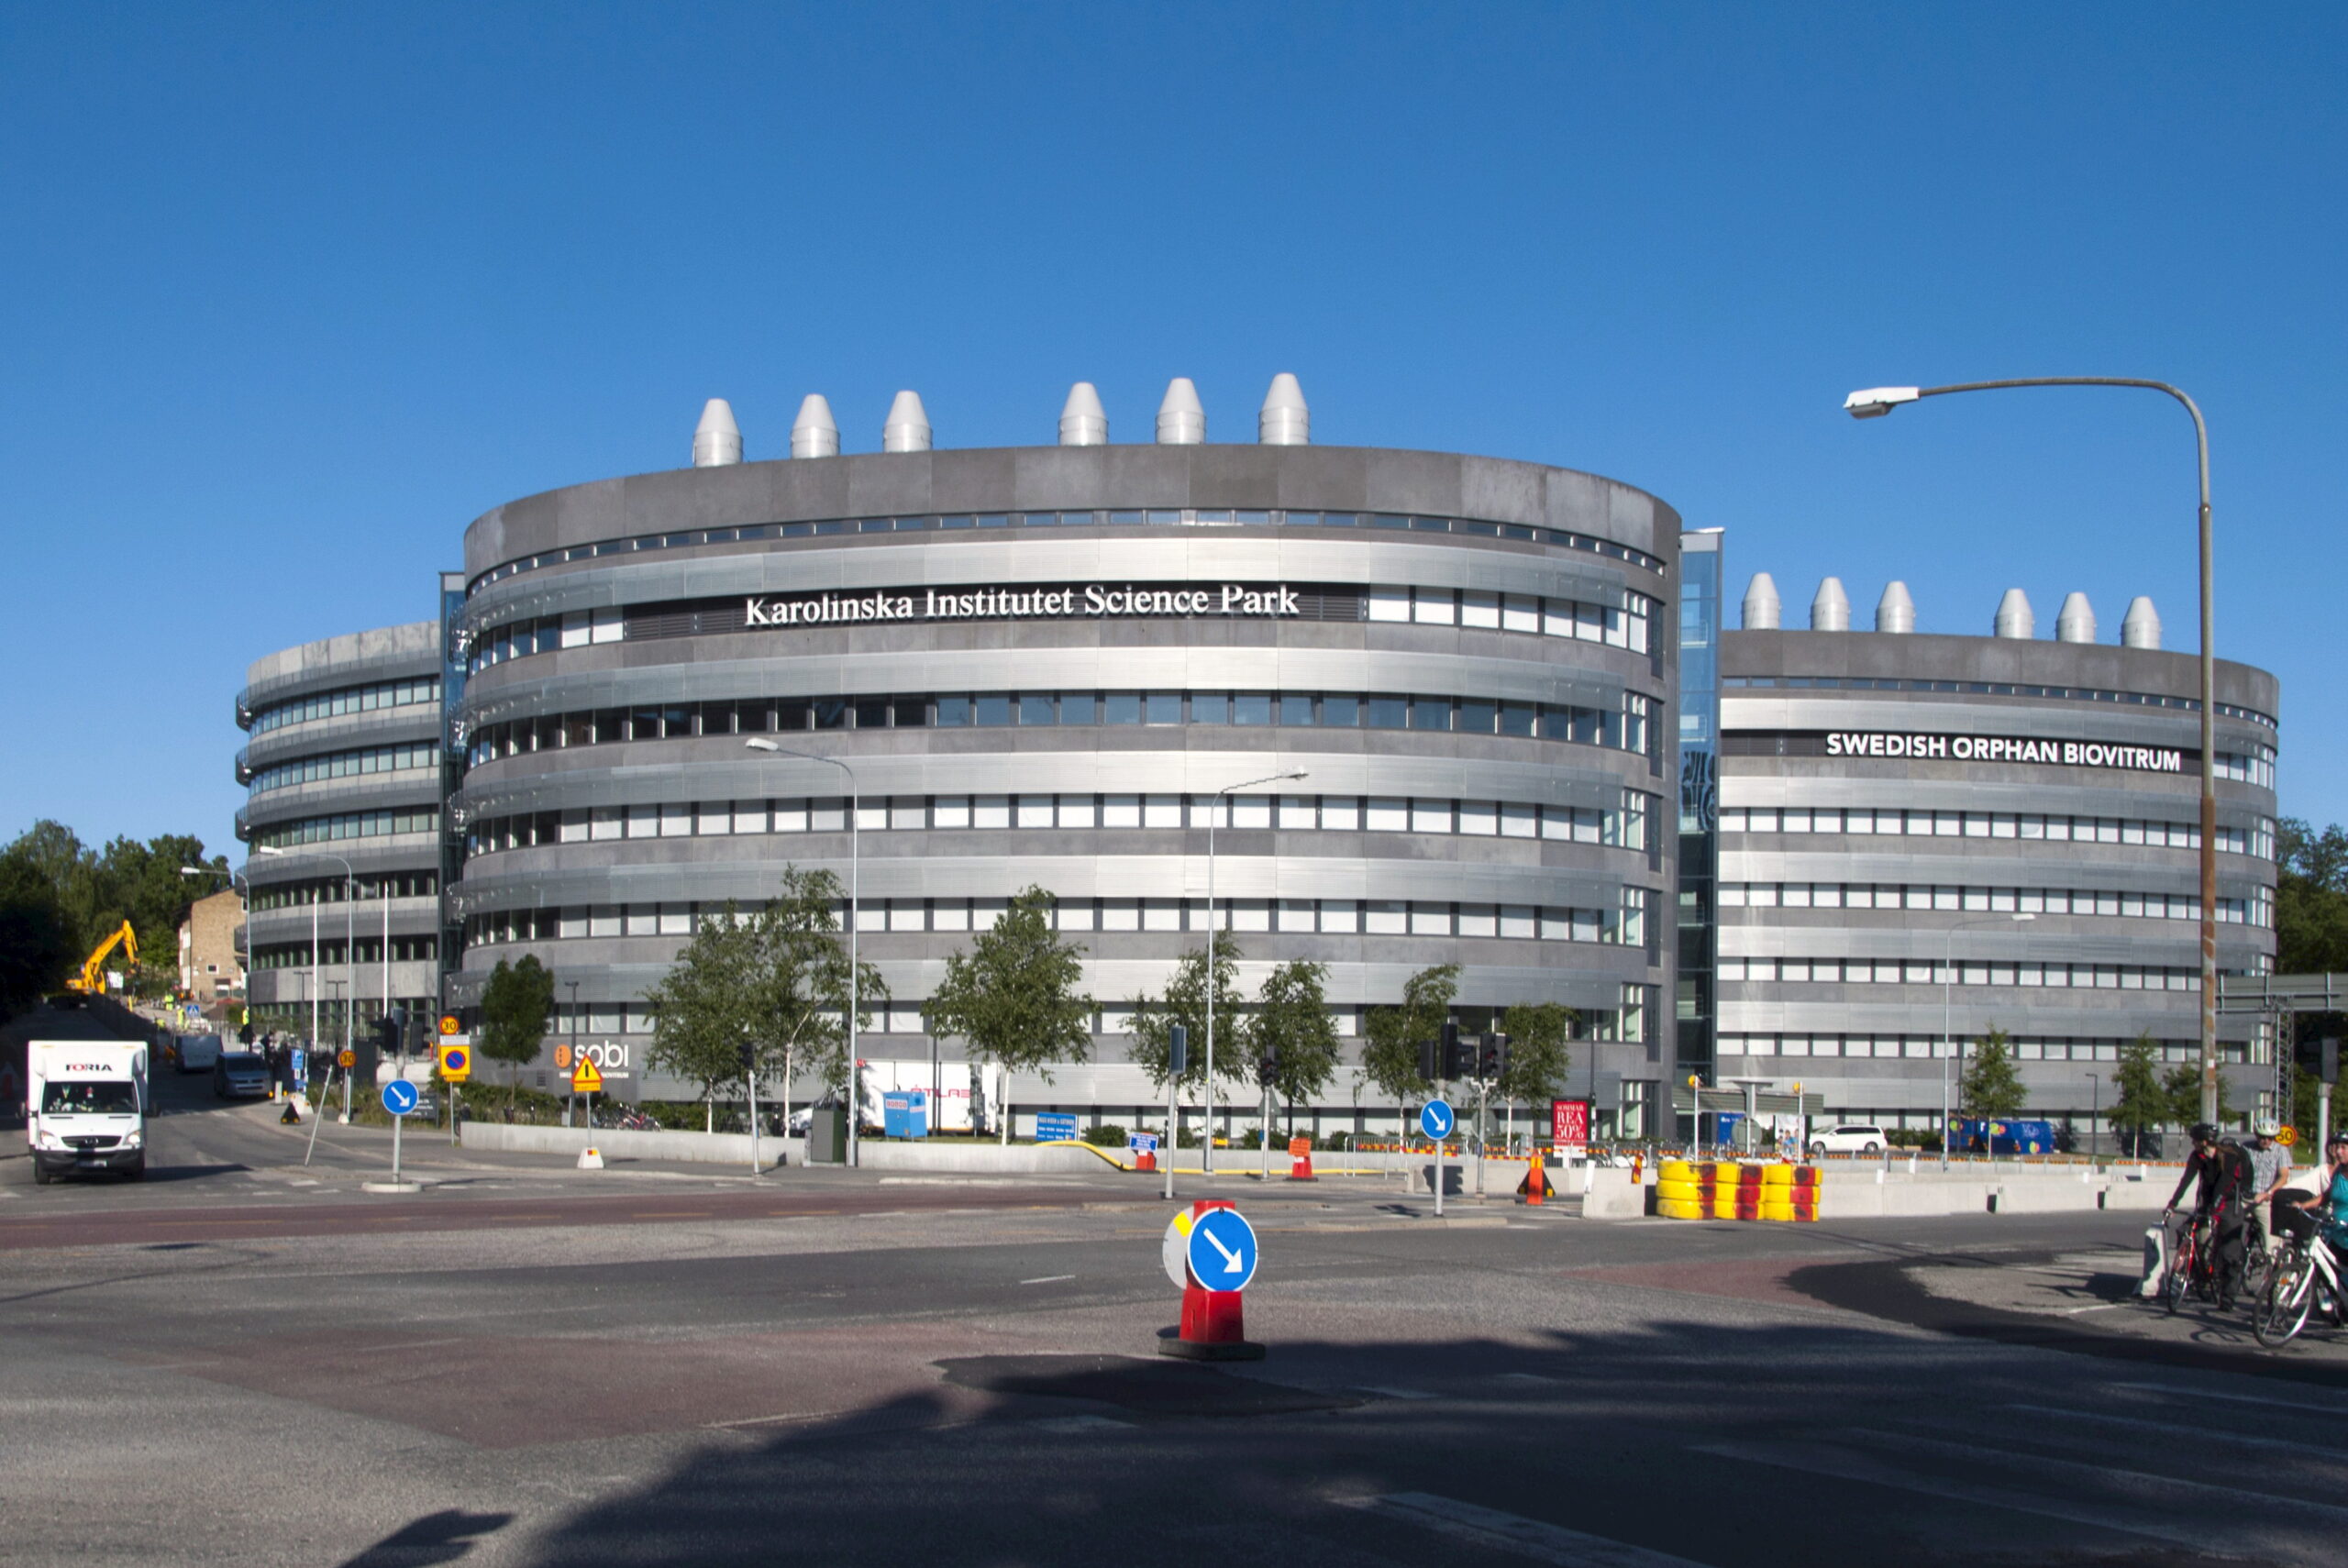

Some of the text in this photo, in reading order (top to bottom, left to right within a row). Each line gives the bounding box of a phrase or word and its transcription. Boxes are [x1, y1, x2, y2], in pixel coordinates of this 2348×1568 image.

[745, 584, 1301, 625] Karolinska Institutet Science Park
[1826, 733, 2181, 772] SWEDISH ORPHAN BIOVITRUM
[444, 1021, 456, 1031] 30
[65, 1063, 113, 1072] FORIA
[1556, 1110, 1584, 1124] REA
[1556, 1124, 1585, 1139] 50%
